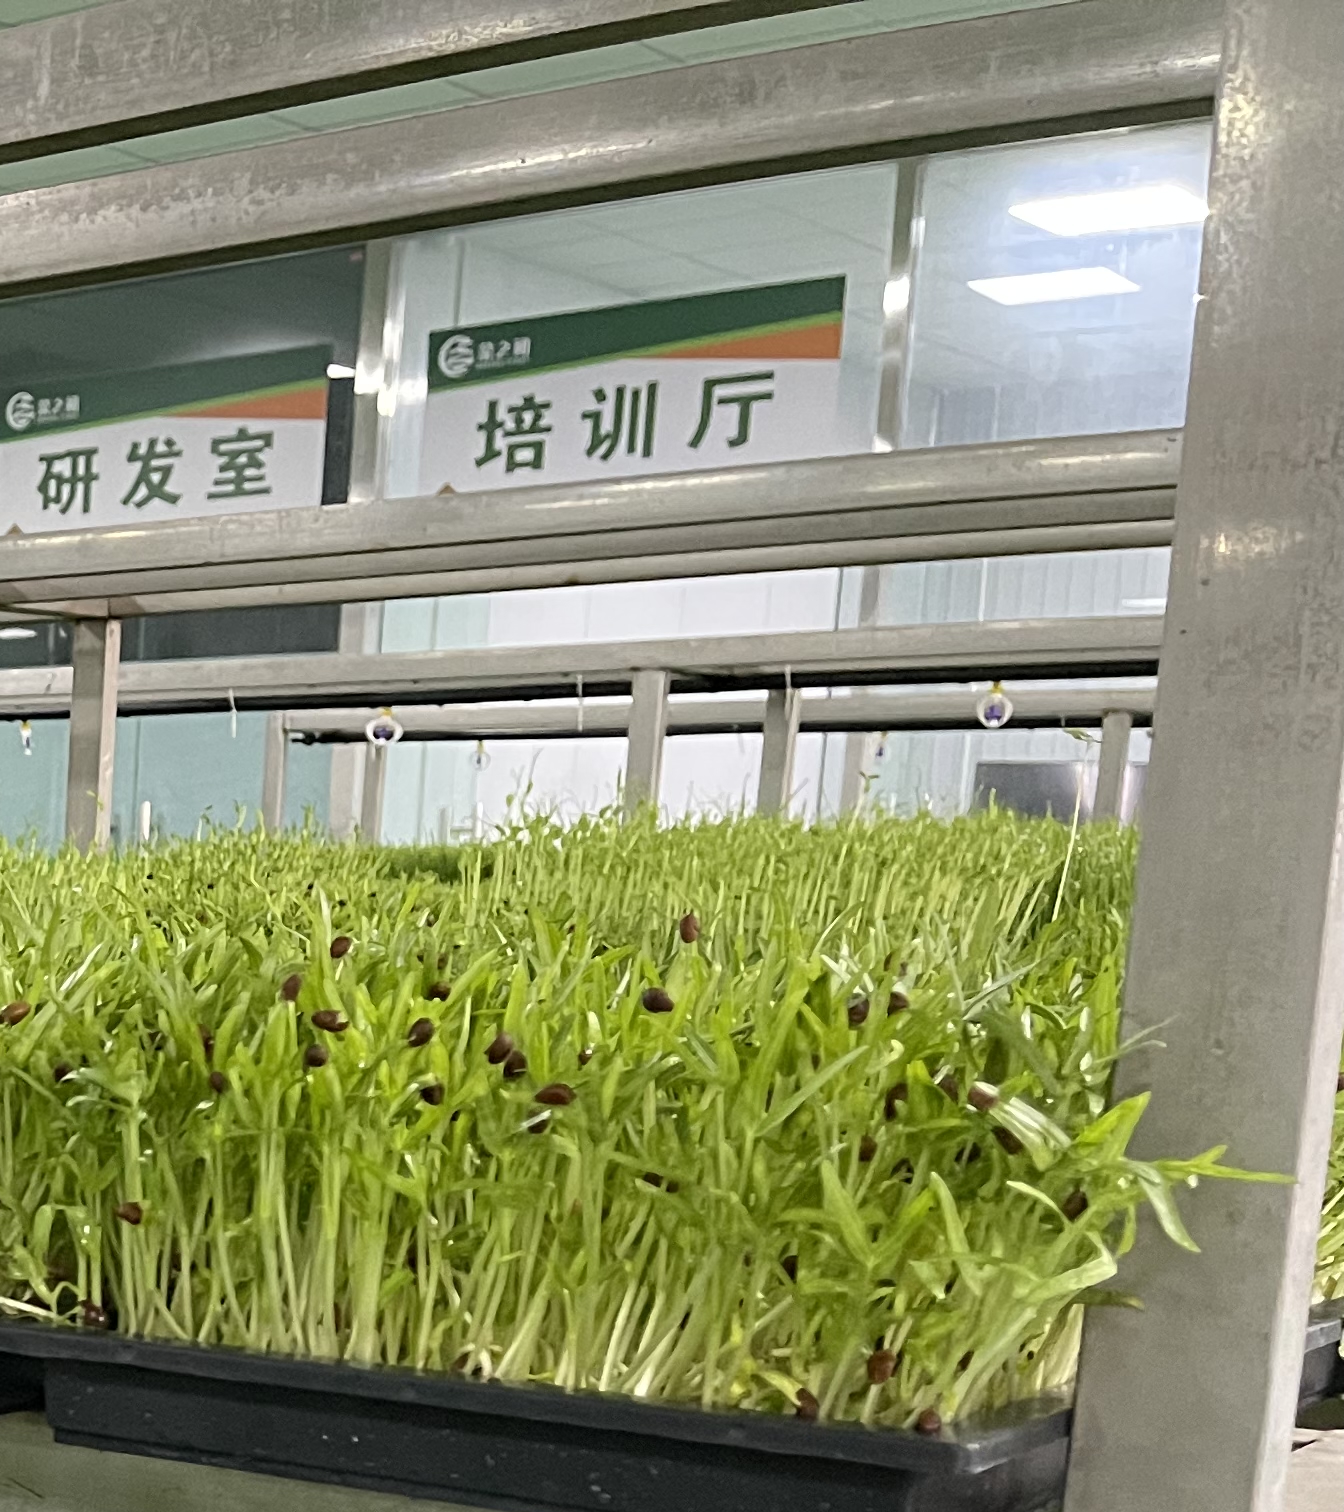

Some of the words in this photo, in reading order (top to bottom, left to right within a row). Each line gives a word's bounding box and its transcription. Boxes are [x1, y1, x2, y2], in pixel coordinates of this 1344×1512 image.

[474, 369, 775, 473] 培训厅
[37, 427, 274, 515] 研发室
